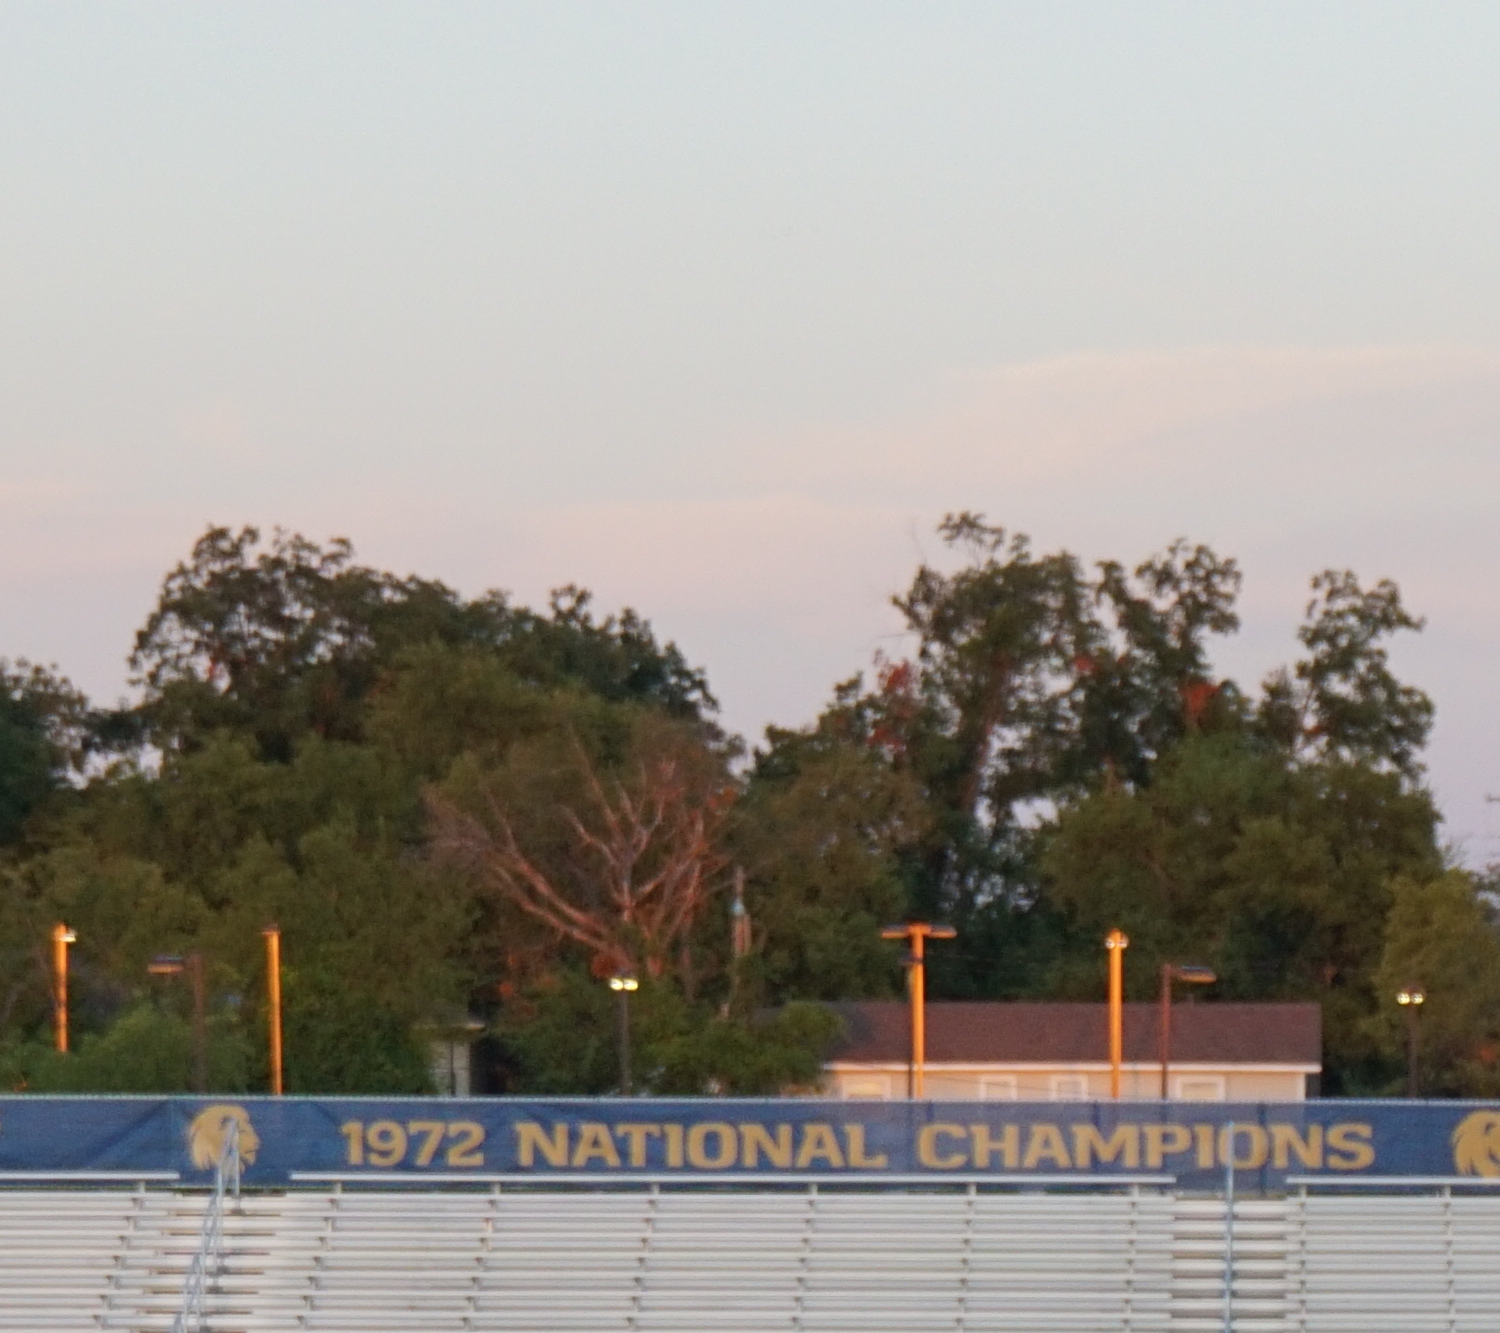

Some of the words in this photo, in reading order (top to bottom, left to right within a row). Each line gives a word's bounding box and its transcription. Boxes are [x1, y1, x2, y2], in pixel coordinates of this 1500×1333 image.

[341, 1120, 486, 1169] 1972
[514, 1121, 888, 1170] NATIONAL
[916, 1121, 1376, 1172] CHAMPIONS
